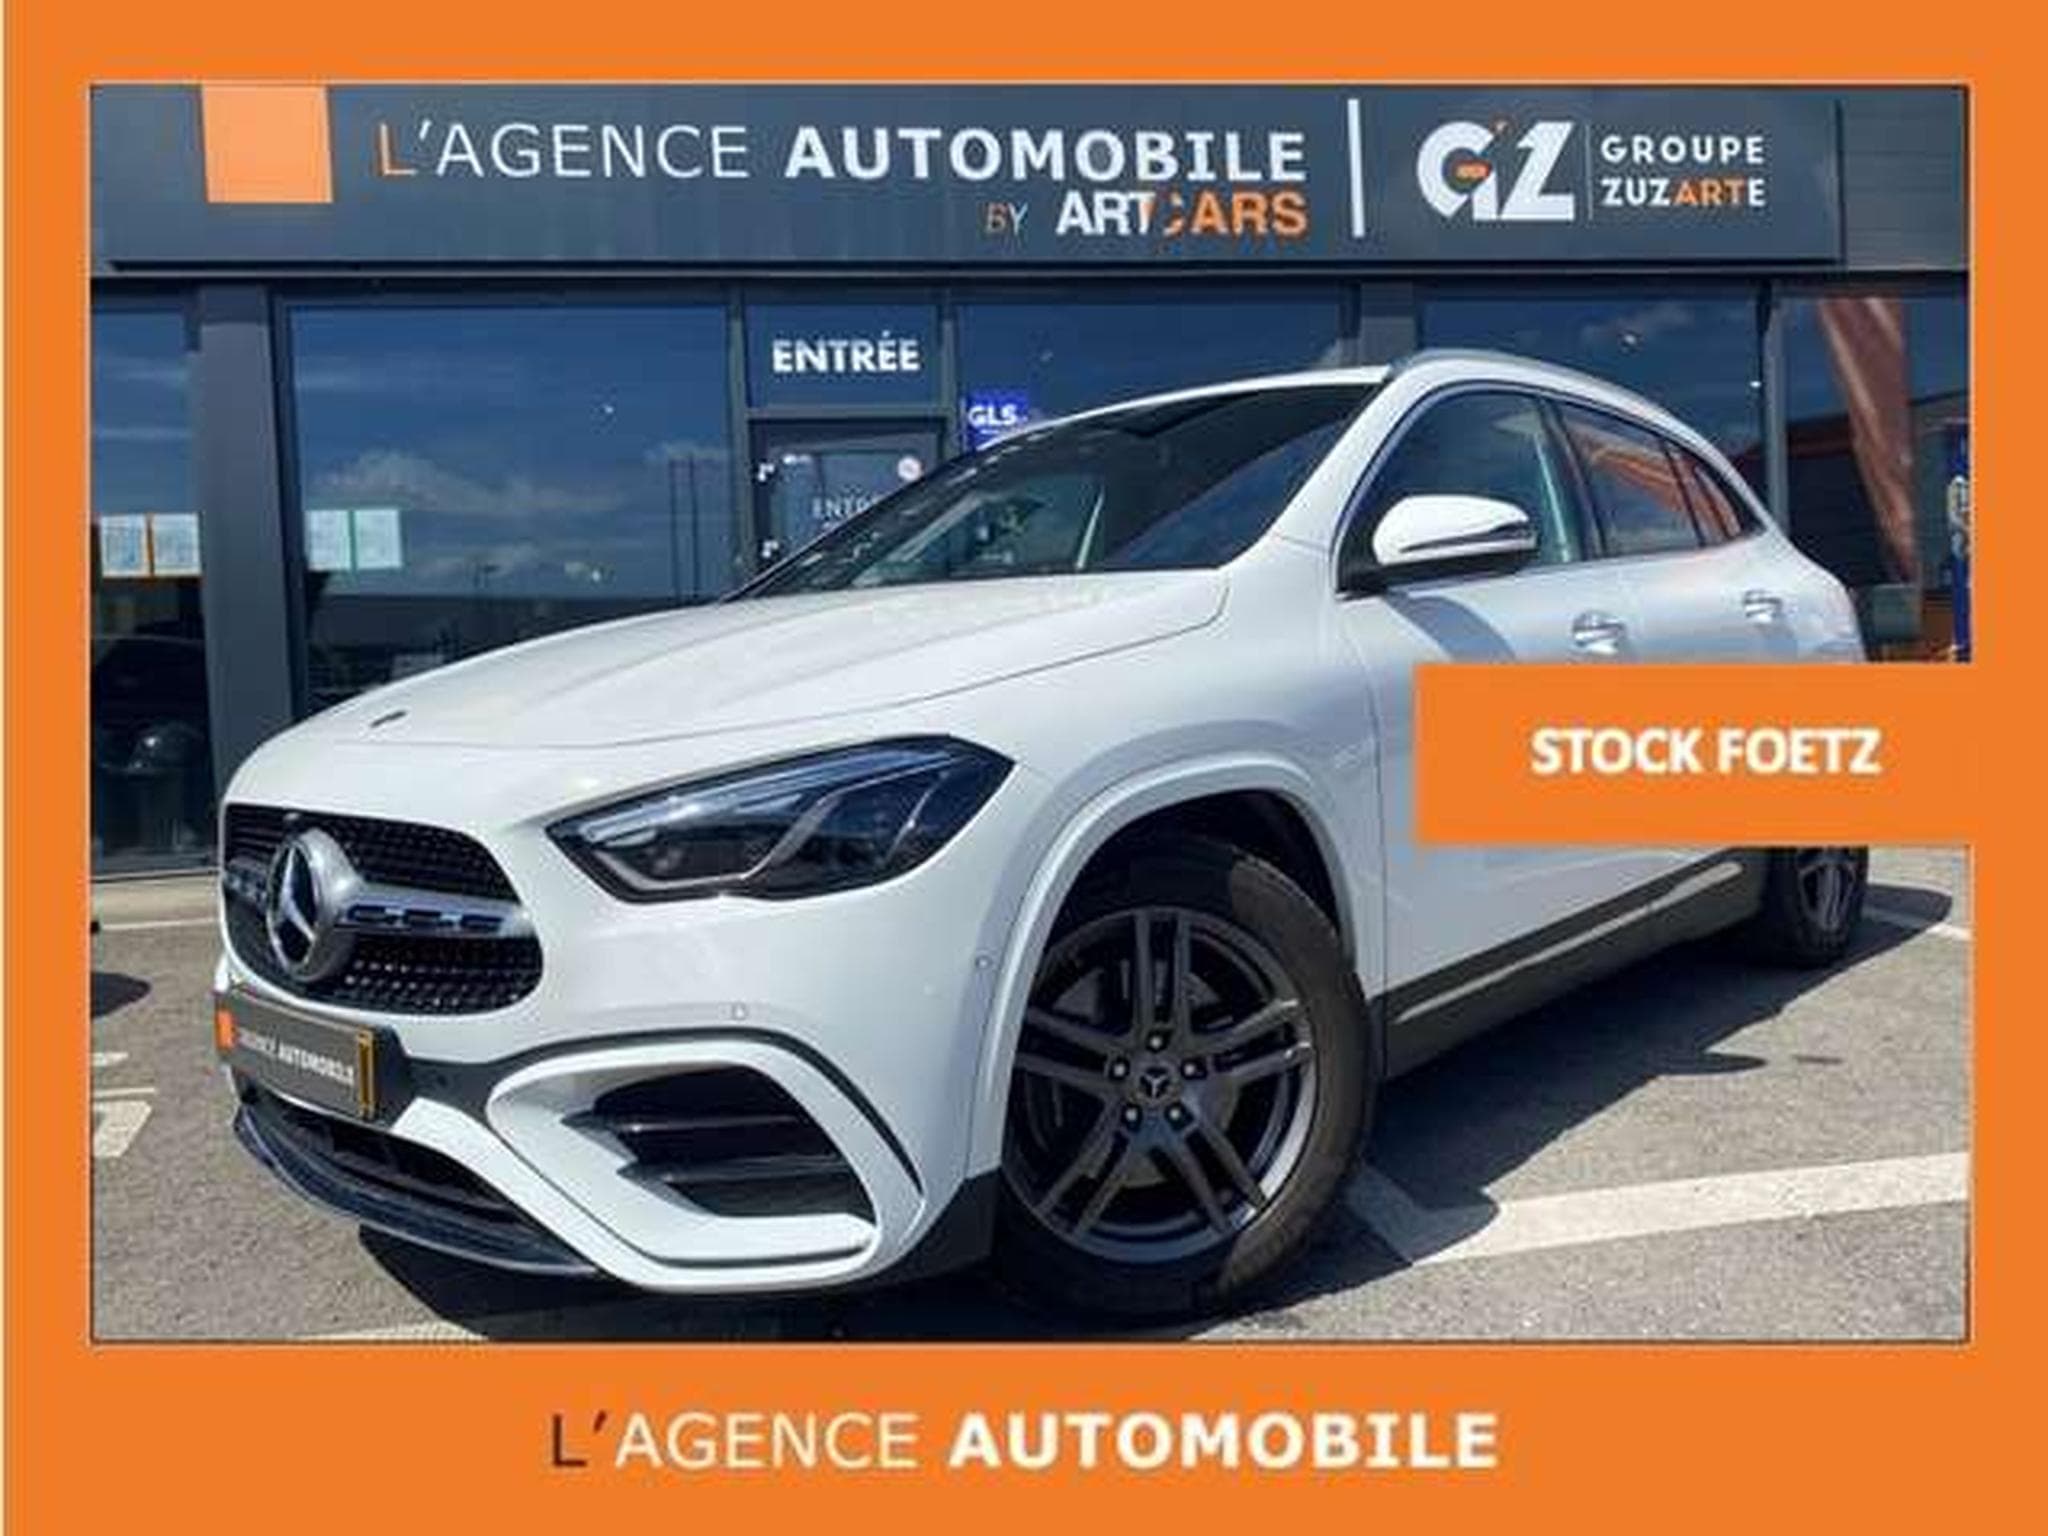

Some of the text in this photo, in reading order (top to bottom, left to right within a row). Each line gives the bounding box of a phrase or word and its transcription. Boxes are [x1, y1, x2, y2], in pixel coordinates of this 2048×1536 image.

[375, 120, 1307, 182] L'AGENCE AUTOMOBILE
[1601, 134, 1766, 166] GROUPE
[1601, 177, 1767, 207] ZUZARTE
[985, 202, 1028, 236] BY
[771, 330, 921, 373] ENTRÉE
